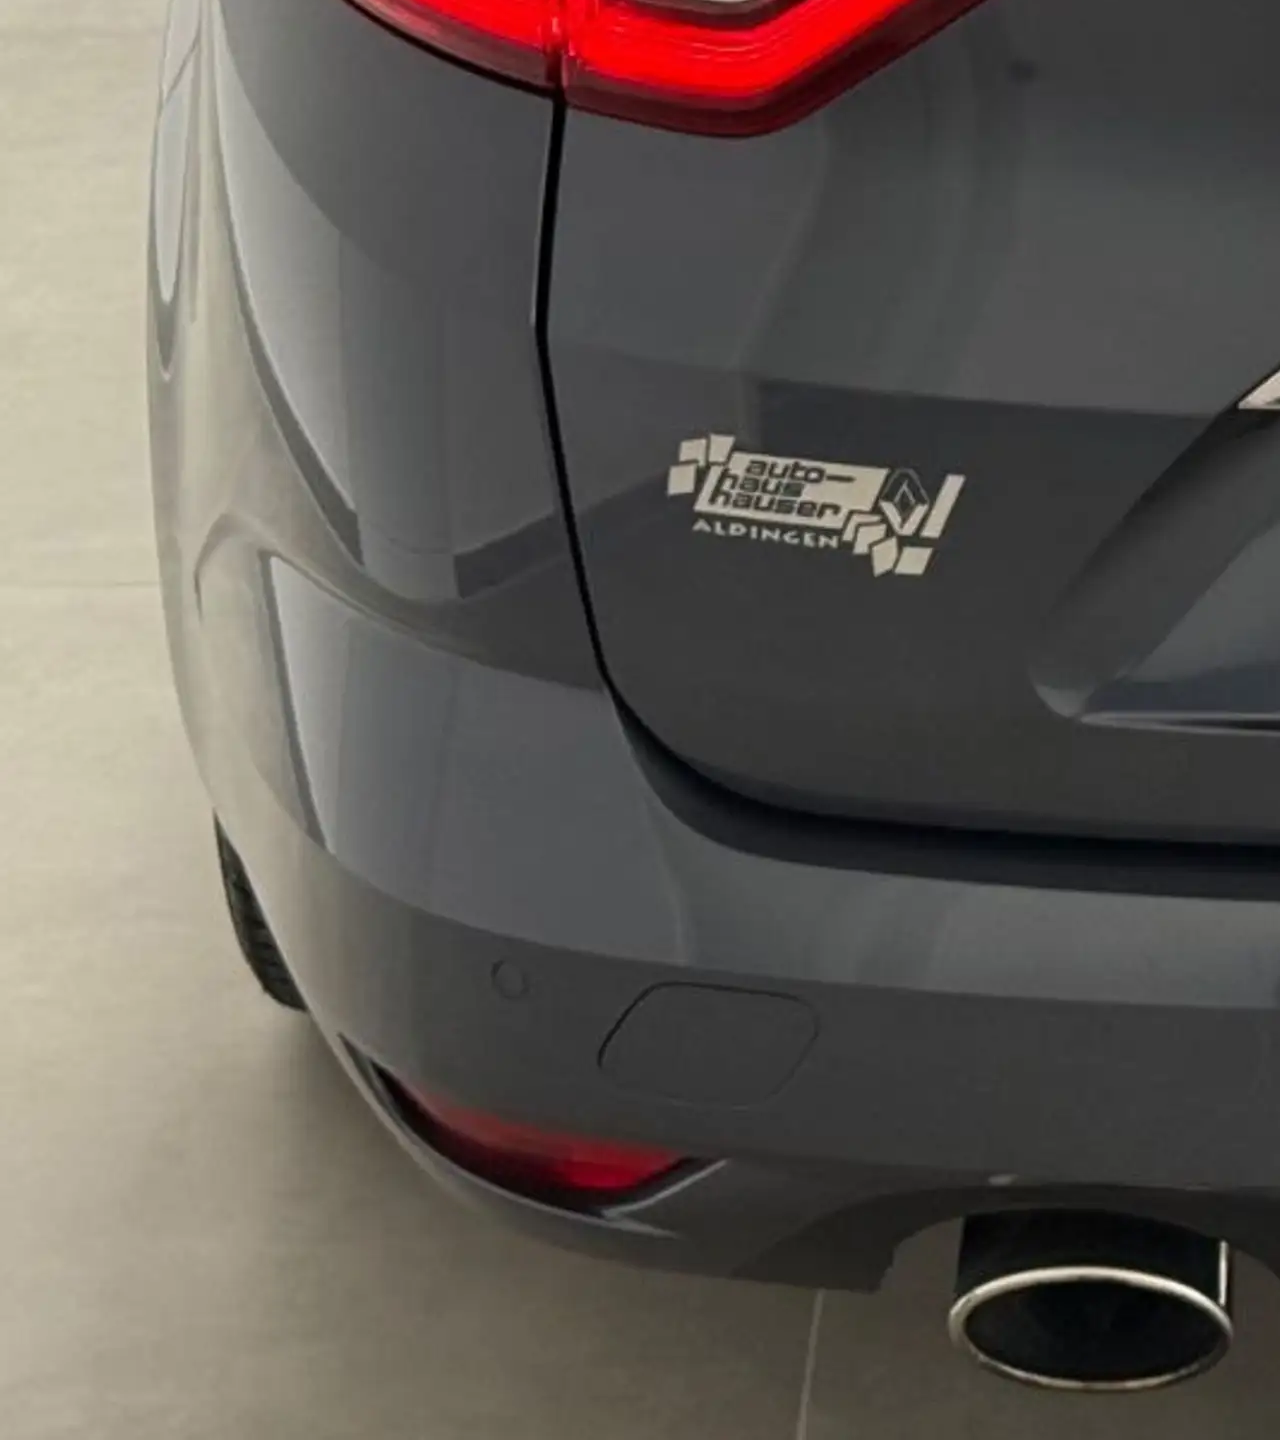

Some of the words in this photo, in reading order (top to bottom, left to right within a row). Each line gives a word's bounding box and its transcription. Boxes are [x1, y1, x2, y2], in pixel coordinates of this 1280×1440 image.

[720, 469, 804, 497] haus
[709, 491, 841, 517] hauser
[693, 520, 839, 548] ALDINGEN
